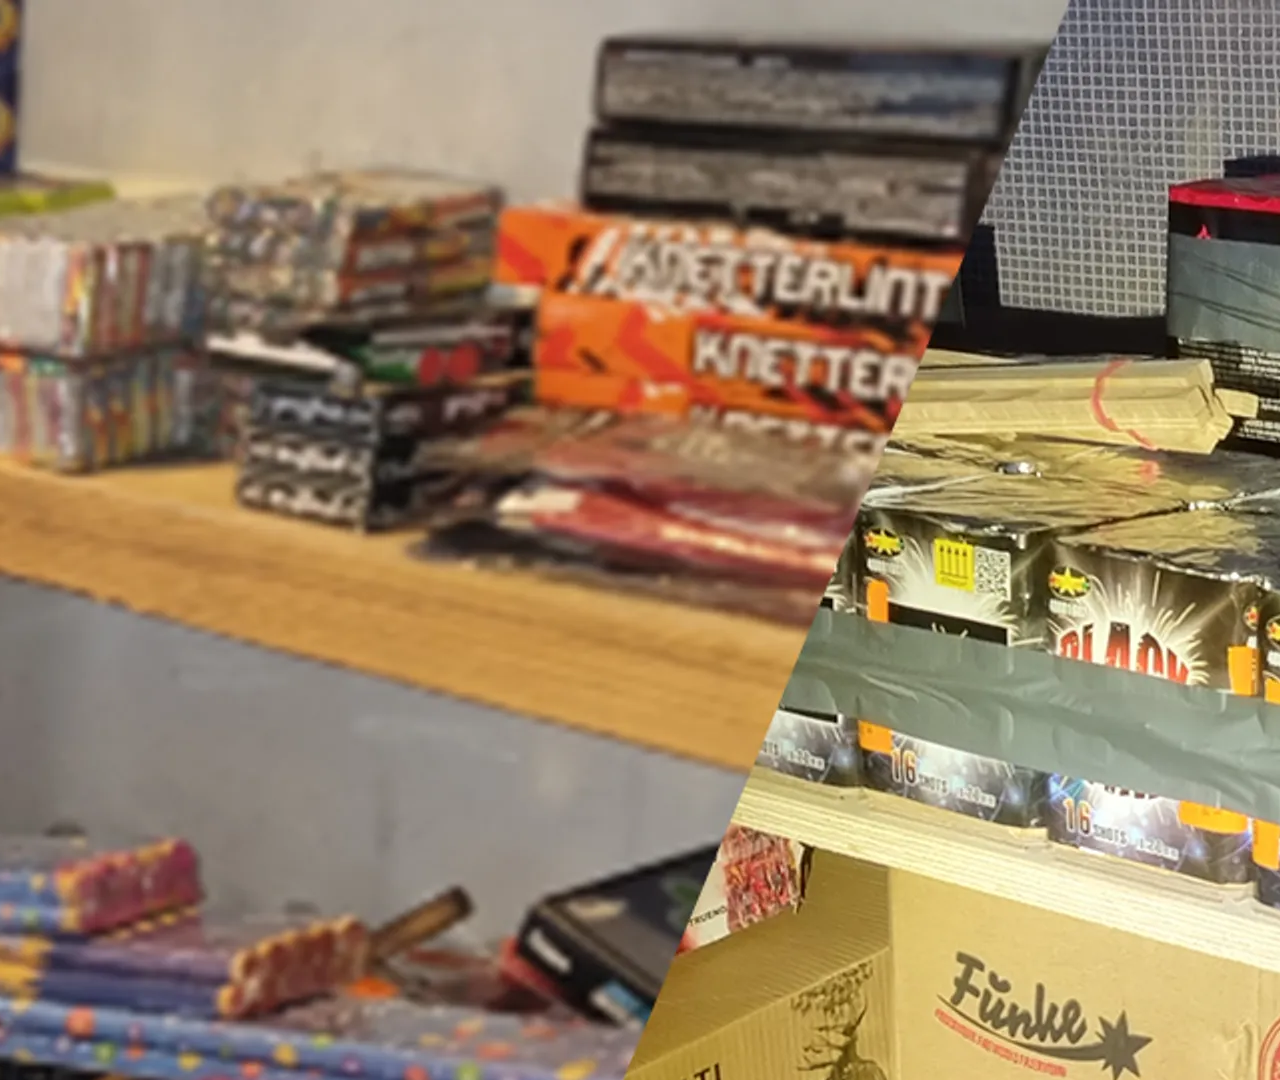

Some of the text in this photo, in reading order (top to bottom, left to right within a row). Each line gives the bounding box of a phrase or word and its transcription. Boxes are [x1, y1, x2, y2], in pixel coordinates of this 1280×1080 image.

[623, 242, 951, 318] KNETTERLINT
[891, 749, 919, 786] 16
[1062, 796, 1092, 837] 16
